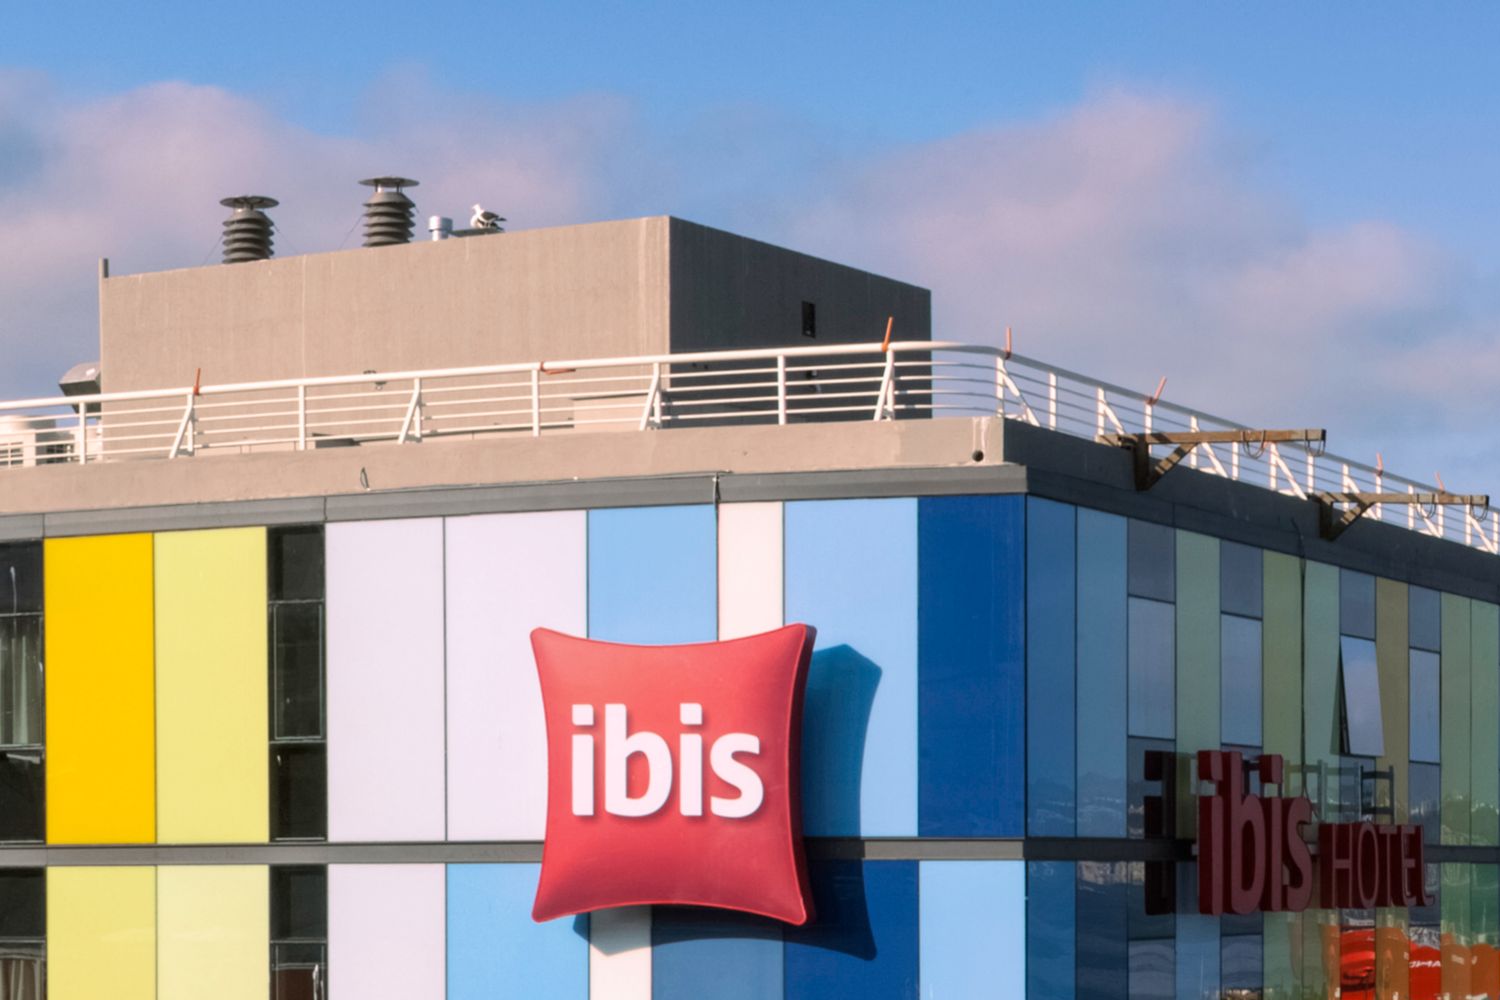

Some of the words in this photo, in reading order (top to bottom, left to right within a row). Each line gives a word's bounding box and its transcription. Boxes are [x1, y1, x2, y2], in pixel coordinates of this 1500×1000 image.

[571, 703, 764, 818] ibis
[1198, 750, 1313, 915] ibis
[1320, 822, 1435, 909] HOTEL
